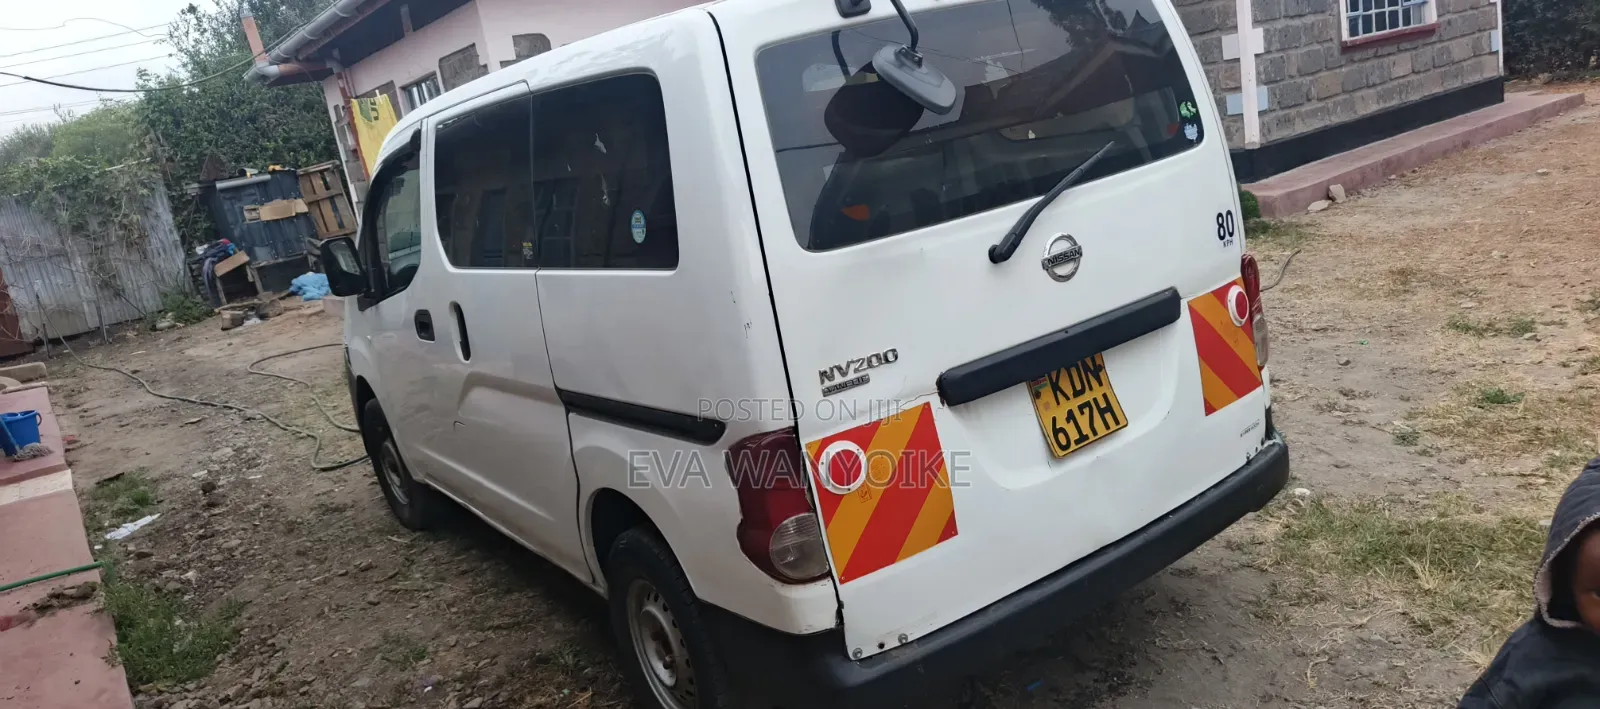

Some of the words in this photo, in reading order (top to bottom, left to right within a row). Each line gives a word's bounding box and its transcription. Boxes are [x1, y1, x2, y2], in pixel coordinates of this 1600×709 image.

[1216, 209, 1235, 241] 80
[1047, 248, 1081, 266] NISSAN
[818, 348, 899, 385] NV200
[1047, 355, 1104, 406] KDN
[1051, 392, 1121, 452] 617H
